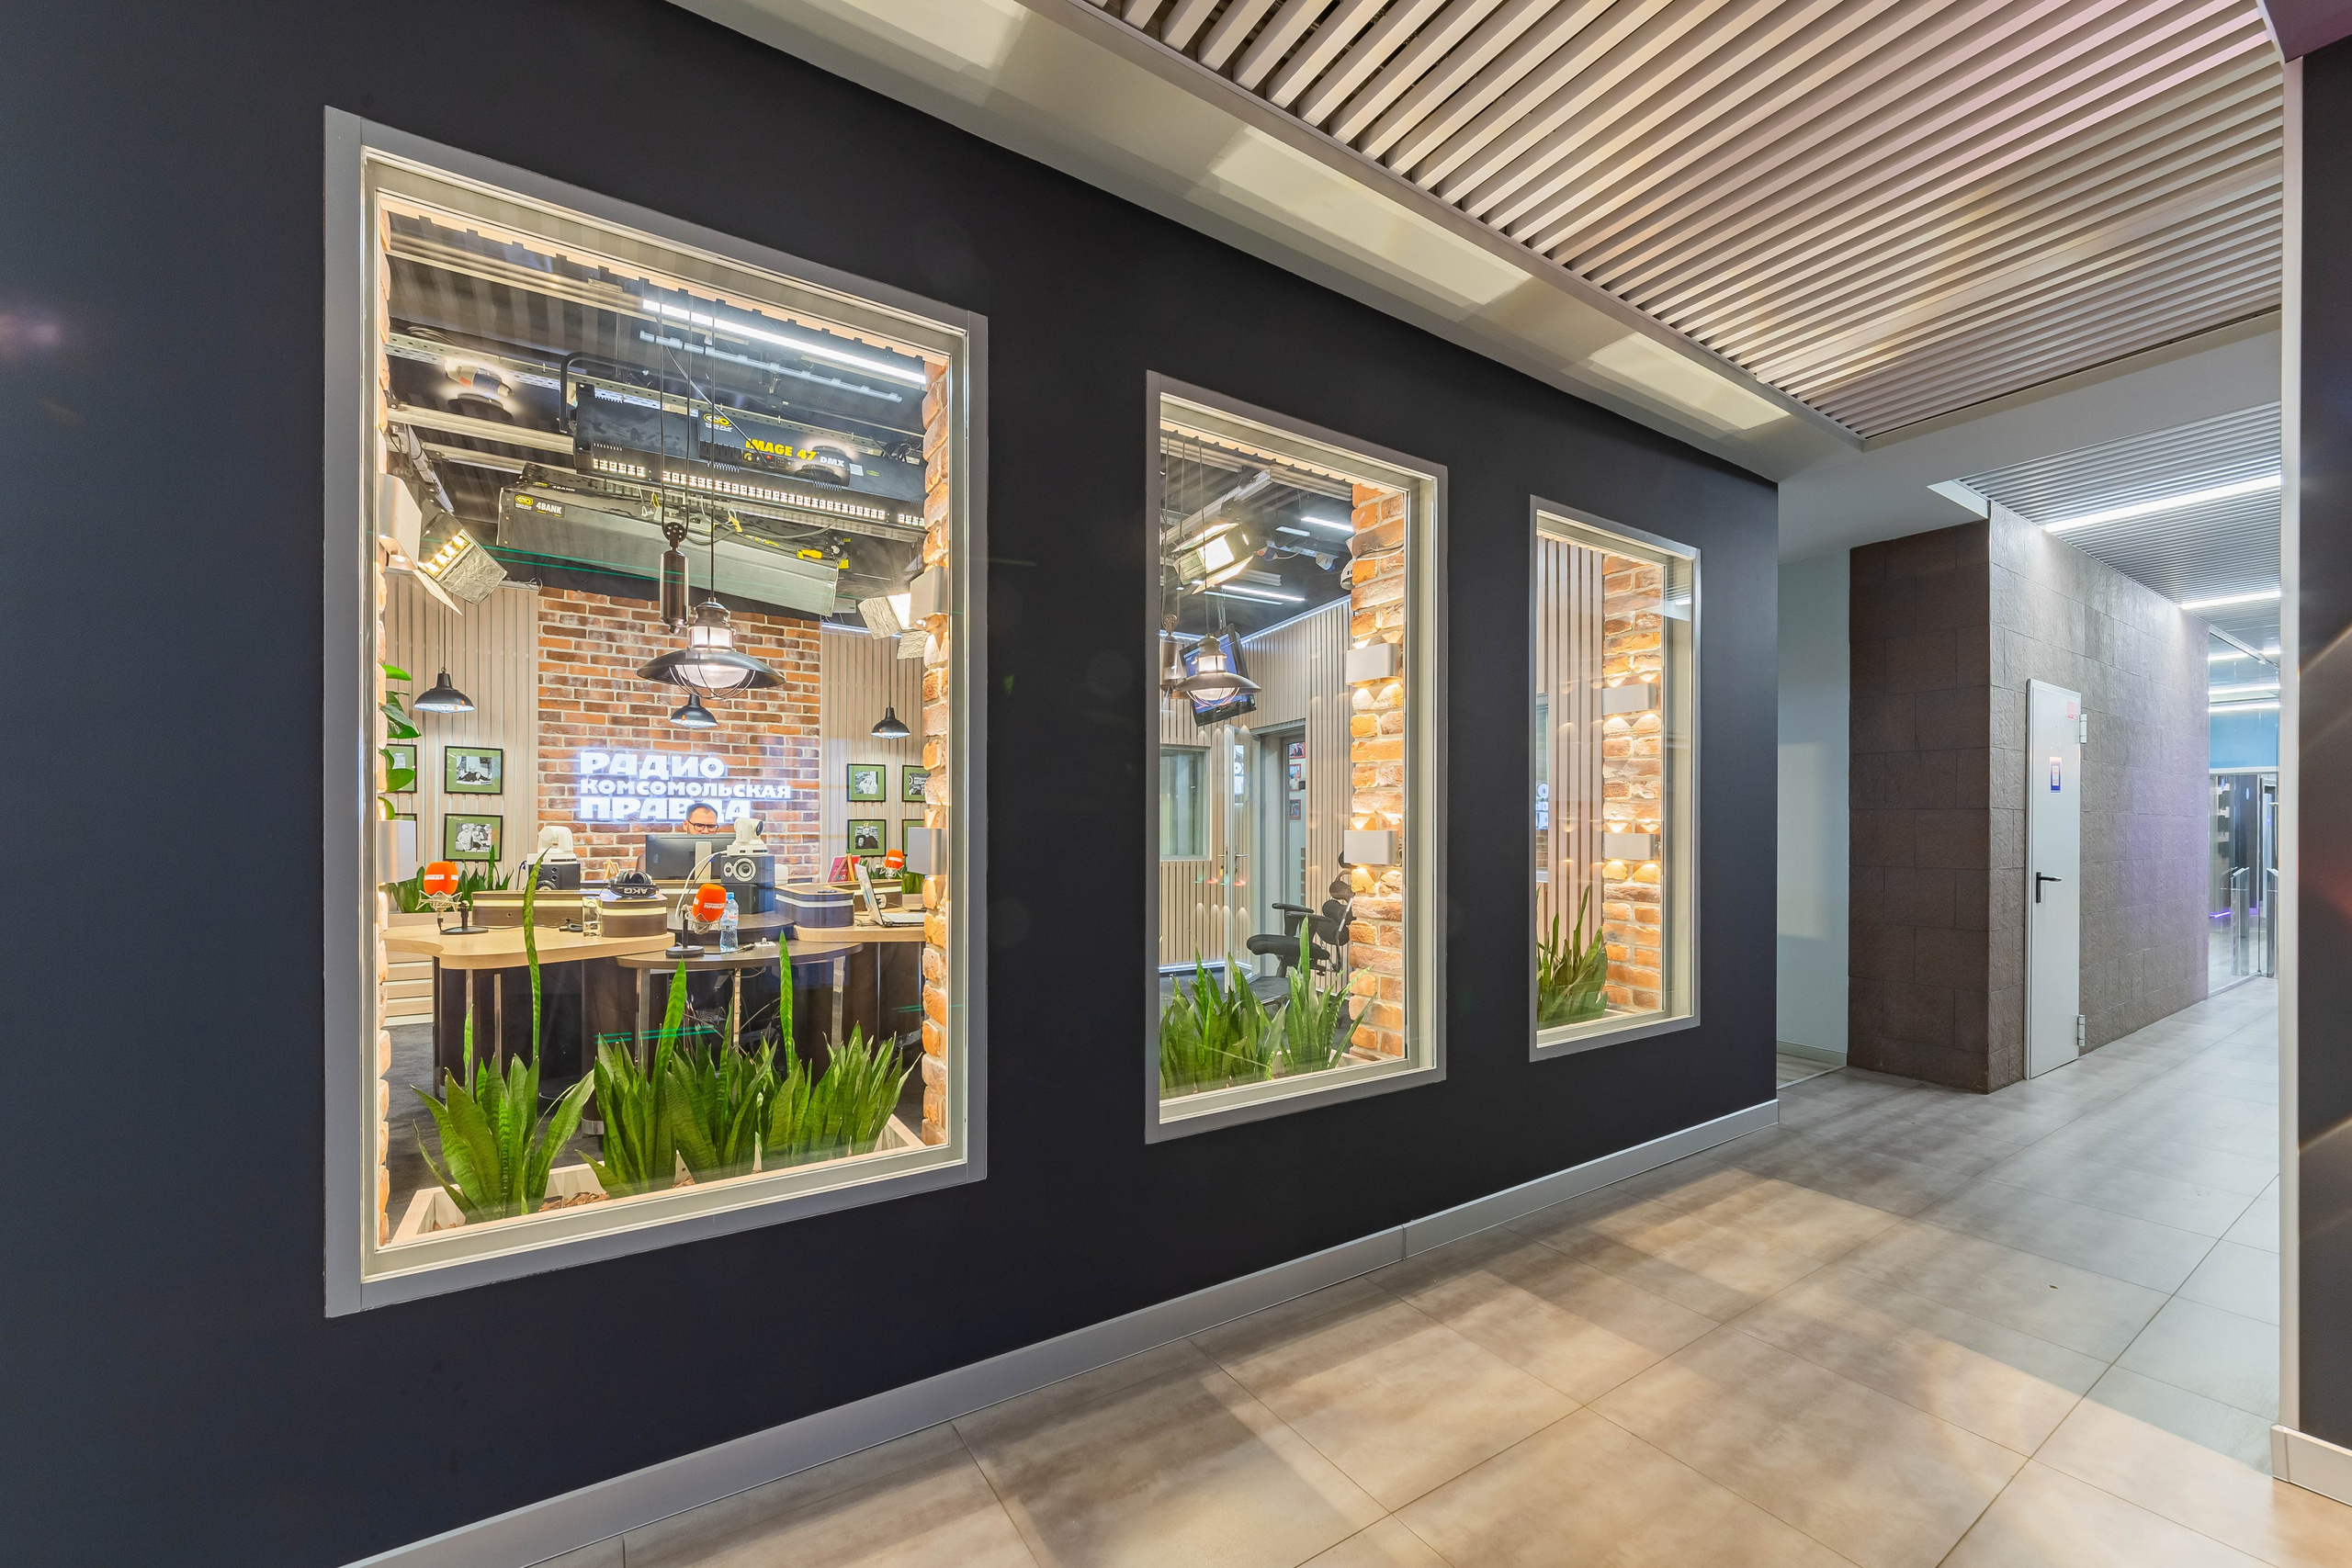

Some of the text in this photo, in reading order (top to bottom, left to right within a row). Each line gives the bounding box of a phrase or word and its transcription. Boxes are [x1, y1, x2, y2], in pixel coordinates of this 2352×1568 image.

[745, 438, 817, 461] IMAGE 47
[820, 456, 844, 468] DMX
[536, 502, 561, 514] 4BANK
[580, 751, 725, 780] РАДИО
[580, 780, 791, 798] КОМСОМОЛЬСКАЯ
